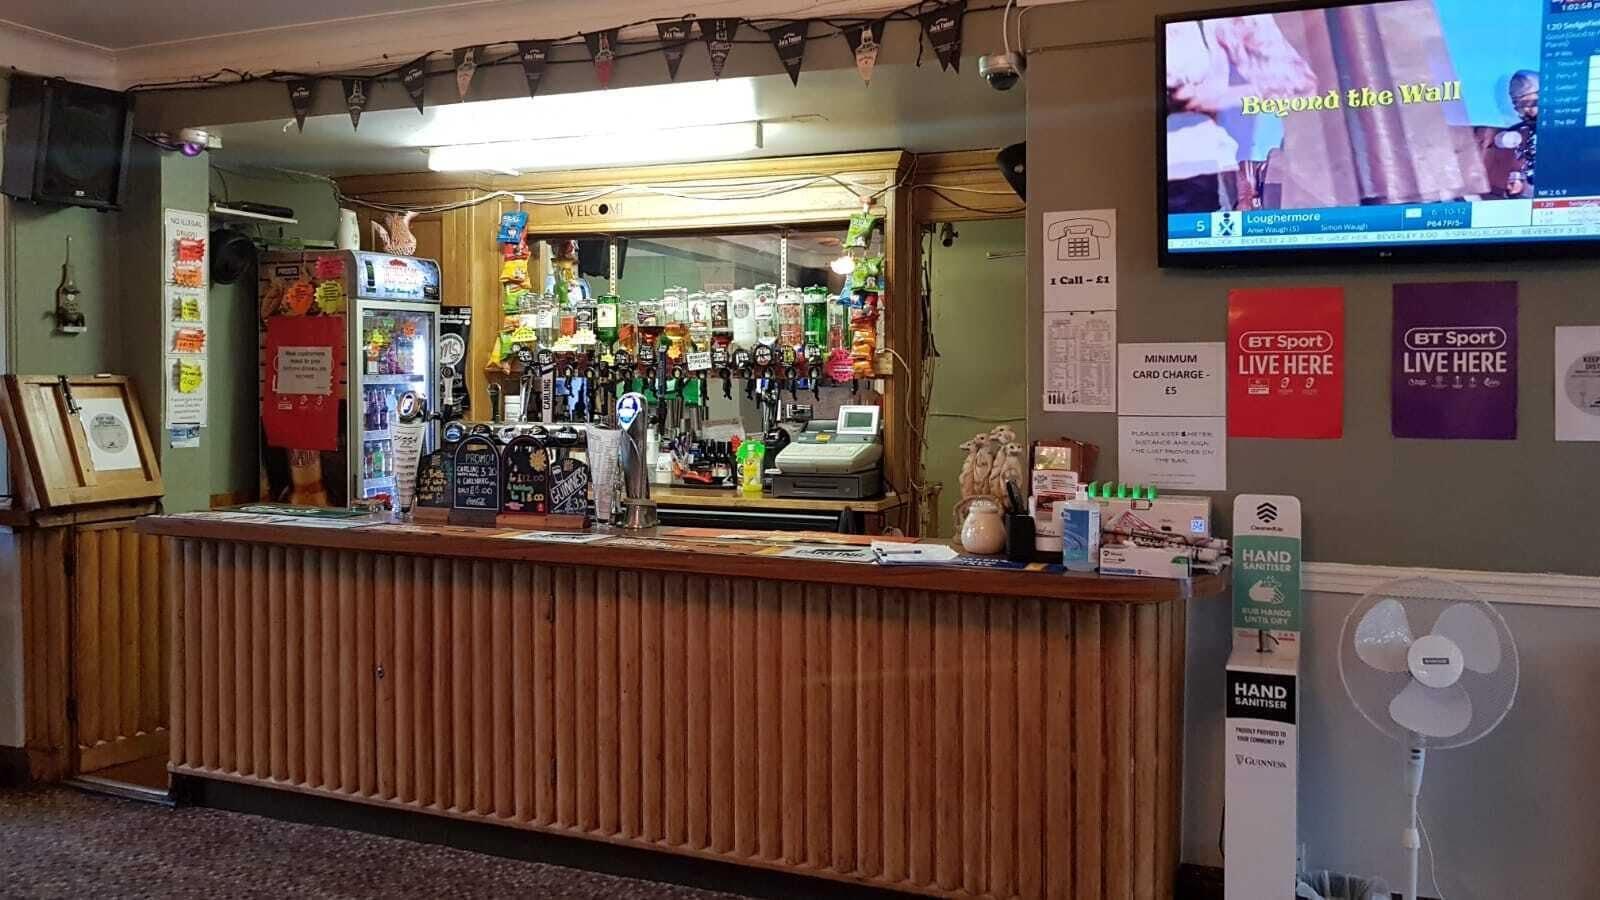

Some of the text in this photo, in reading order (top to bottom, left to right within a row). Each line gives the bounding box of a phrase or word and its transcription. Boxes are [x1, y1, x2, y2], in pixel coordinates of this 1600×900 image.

[1240, 81, 1461, 117] Beyond the Wall
[1246, 212, 1321, 225] Loughermore
[1196, 220, 1206, 232] 5
[1059, 275, 1083, 285] Call
[1095, 275, 1110, 284] £1
[1248, 334, 1323, 350] BT Sport
[1414, 331, 1497, 347] BT Sport
[1144, 354, 1198, 363] MINIMUM
[1239, 354, 1334, 375] LIVE HERE
[1403, 352, 1508, 373] LIVE HERE
[1132, 370, 1160, 379] CARD
[1162, 370, 1205, 379] CHARGE
[543, 379, 552, 410] CARLING
[1165, 386, 1177, 395] £5
[465, 453, 495, 465] PROMO!
[550, 466, 587, 505] GUINNESS
[1242, 549, 1292, 564] HAND
[1242, 562, 1292, 573] SANITISER
[1260, 608, 1292, 617] HANDS
[1234, 682, 1287, 700] HAND
[1234, 697, 1288, 710] SANITISER
[1244, 756, 1288, 769] GUINNESS
